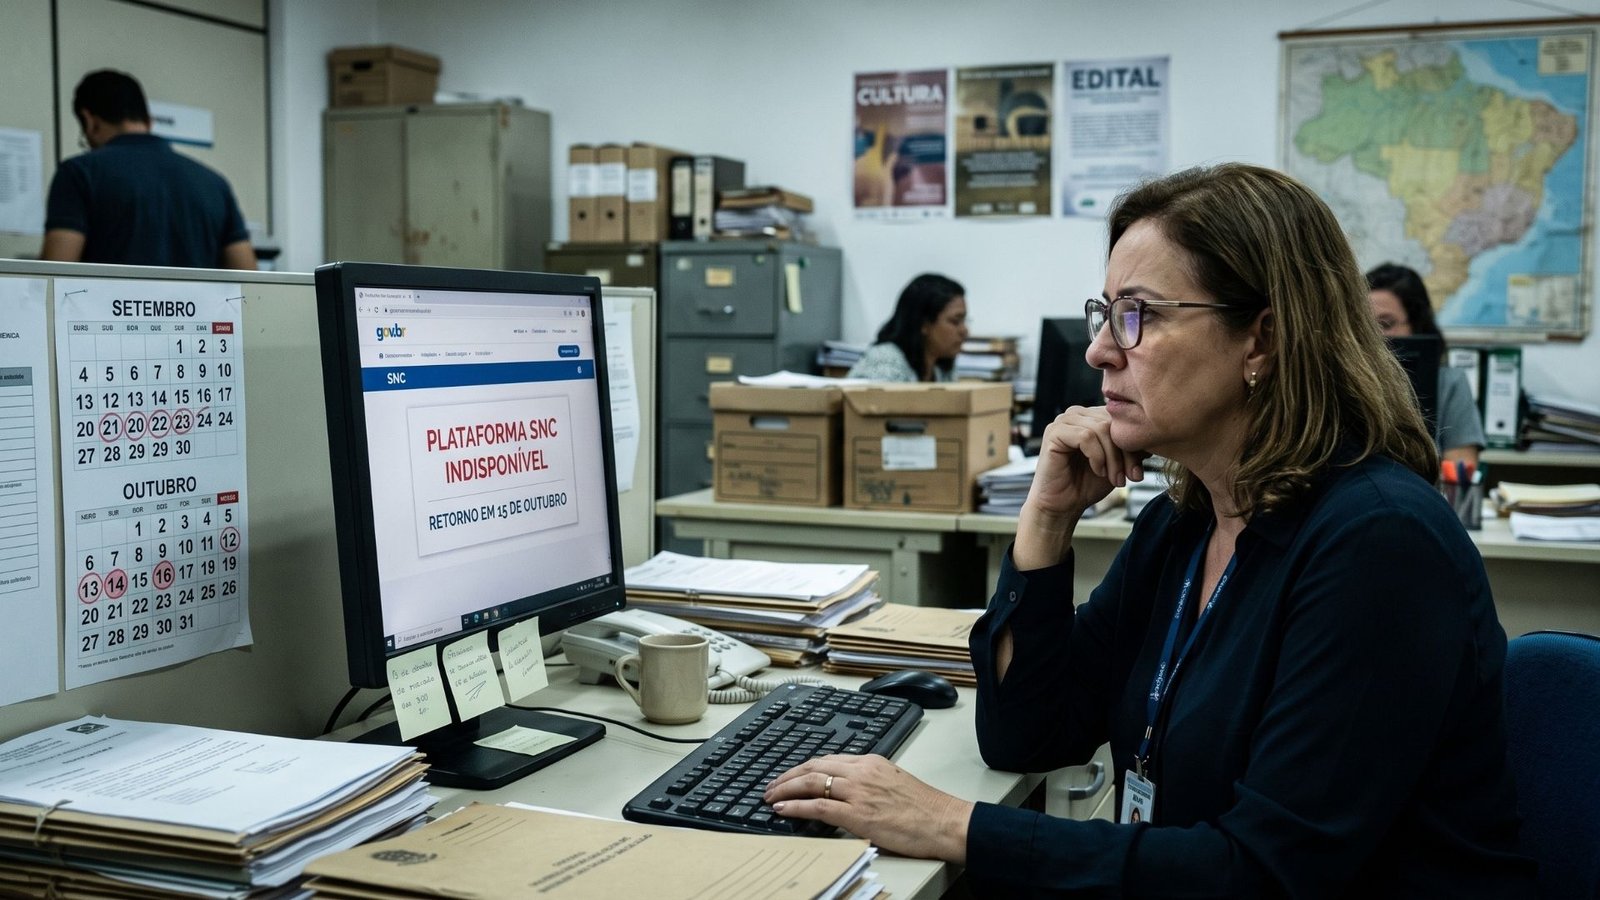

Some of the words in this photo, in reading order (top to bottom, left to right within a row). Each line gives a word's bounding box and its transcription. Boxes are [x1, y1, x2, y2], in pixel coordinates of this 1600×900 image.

[1071, 68, 1160, 90] EDITAL
[857, 84, 943, 106] CULTURA
[113, 300, 195, 317] SETEMBRO
[376, 323, 406, 341] gov.br
[176, 339, 183, 353] 1
[199, 339, 206, 353] 2
[220, 339, 226, 353] 3
[79, 367, 88, 382] 4
[106, 367, 113, 381] 5
[131, 366, 138, 380] 6
[154, 365, 161, 379] 7
[178, 365, 184, 378] 8
[199, 364, 206, 378] 9
[218, 363, 231, 377] 10
[387, 372, 406, 384] SNC
[77, 394, 93, 409] 13
[103, 393, 119, 408] 12
[128, 392, 143, 406] 13
[152, 391, 167, 405] 14
[175, 390, 189, 404] 15
[197, 388, 211, 402] 16
[219, 387, 231, 401] 17
[77, 421, 94, 437] 20
[103, 419, 118, 435] 21
[128, 417, 144, 434] 20
[152, 415, 168, 432] 22
[175, 413, 190, 430] 23
[197, 412, 212, 427] 24
[219, 412, 233, 426] 24
[427, 421, 527, 452] PLATAFORMA
[530, 418, 557, 439] SNC
[78, 448, 95, 464] 27
[104, 446, 120, 462] 28
[129, 444, 144, 459] 29
[153, 442, 168, 457] 29
[176, 440, 190, 454] 30
[445, 447, 548, 483] INDISPONÍVEL
[124, 476, 196, 499] OUTUBRO
[135, 522, 141, 536] 1
[159, 518, 166, 533] 2
[182, 515, 188, 529] 3
[204, 512, 210, 525] 4
[225, 509, 232, 522] 5
[429, 508, 478, 530] RETORNO
[481, 505, 495, 520] EM
[498, 505, 507, 518] 15
[510, 501, 522, 515] DE
[524, 493, 567, 512] OUTUBRO
[86, 555, 94, 570] 6
[111, 551, 118, 566] 7
[136, 547, 142, 562] 8
[159, 544, 166, 558] 9
[179, 539, 193, 554] 10
[201, 536, 212, 551] 11
[223, 533, 237, 549] 12
[81, 580, 99, 598] 13
[107, 575, 125, 593] 14
[132, 572, 147, 588] 15
[156, 567, 172, 584] 16
[179, 564, 193, 579] 17
[223, 556, 236, 571] 19
[82, 608, 98, 625] 20
[108, 603, 122, 620] 21
[132, 598, 148, 614] 22
[156, 593, 171, 610] 23
[179, 589, 194, 605] 24
[201, 584, 215, 600] 25
[222, 580, 236, 596] 26
[82, 634, 99, 652] 27
[108, 629, 124, 646] 28
[133, 624, 148, 640] 29
[157, 618, 172, 635] 30
[180, 614, 193, 629] 31
